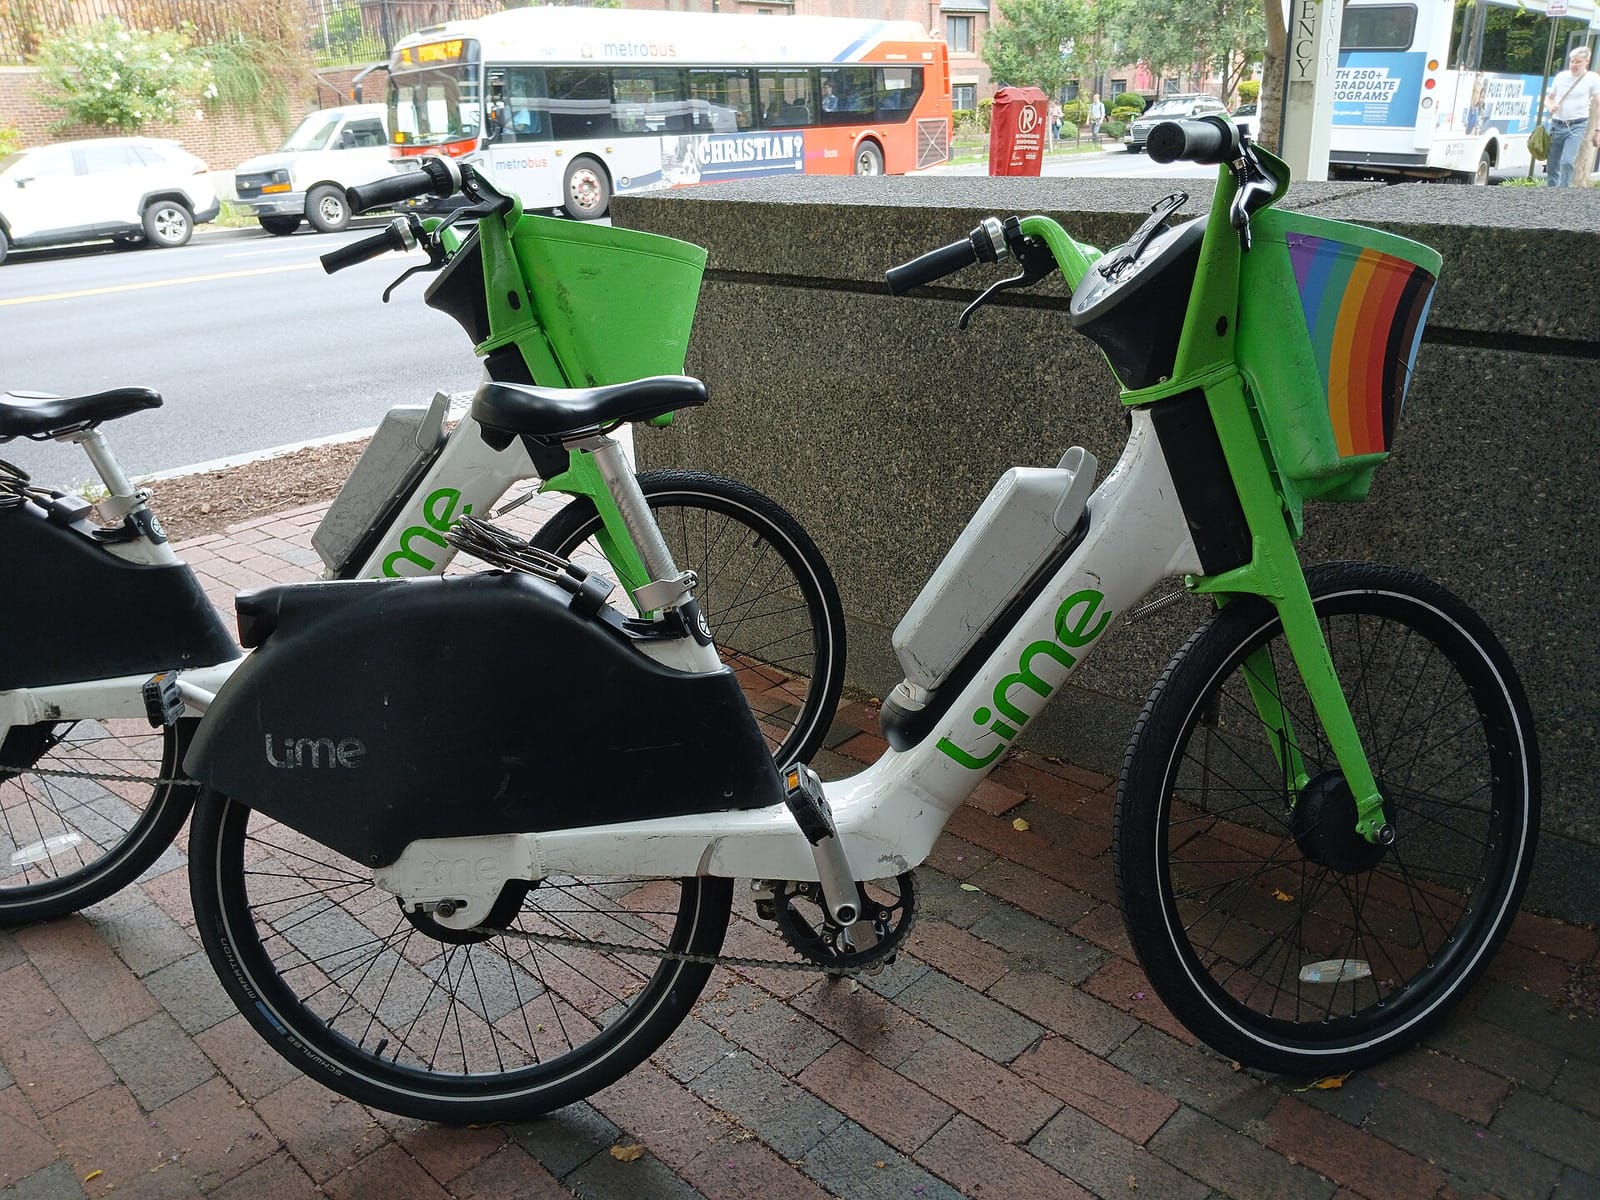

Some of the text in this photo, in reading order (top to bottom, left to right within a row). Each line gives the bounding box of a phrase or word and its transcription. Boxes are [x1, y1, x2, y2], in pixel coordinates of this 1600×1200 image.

[604, 42, 677, 57] metrobus
[1353, 70, 1383, 80] 250+
[1335, 80, 1396, 91] GRADUATE
[1487, 82, 1522, 99] FUEL YOUR
[1334, 91, 1390, 101] OGRAMS
[698, 136, 804, 165] CHRISTIAN?
[495, 156, 548, 171] metrobus
[374, 487, 473, 579] me
[935, 589, 1112, 770] Lime
[265, 733, 367, 769] Lime
